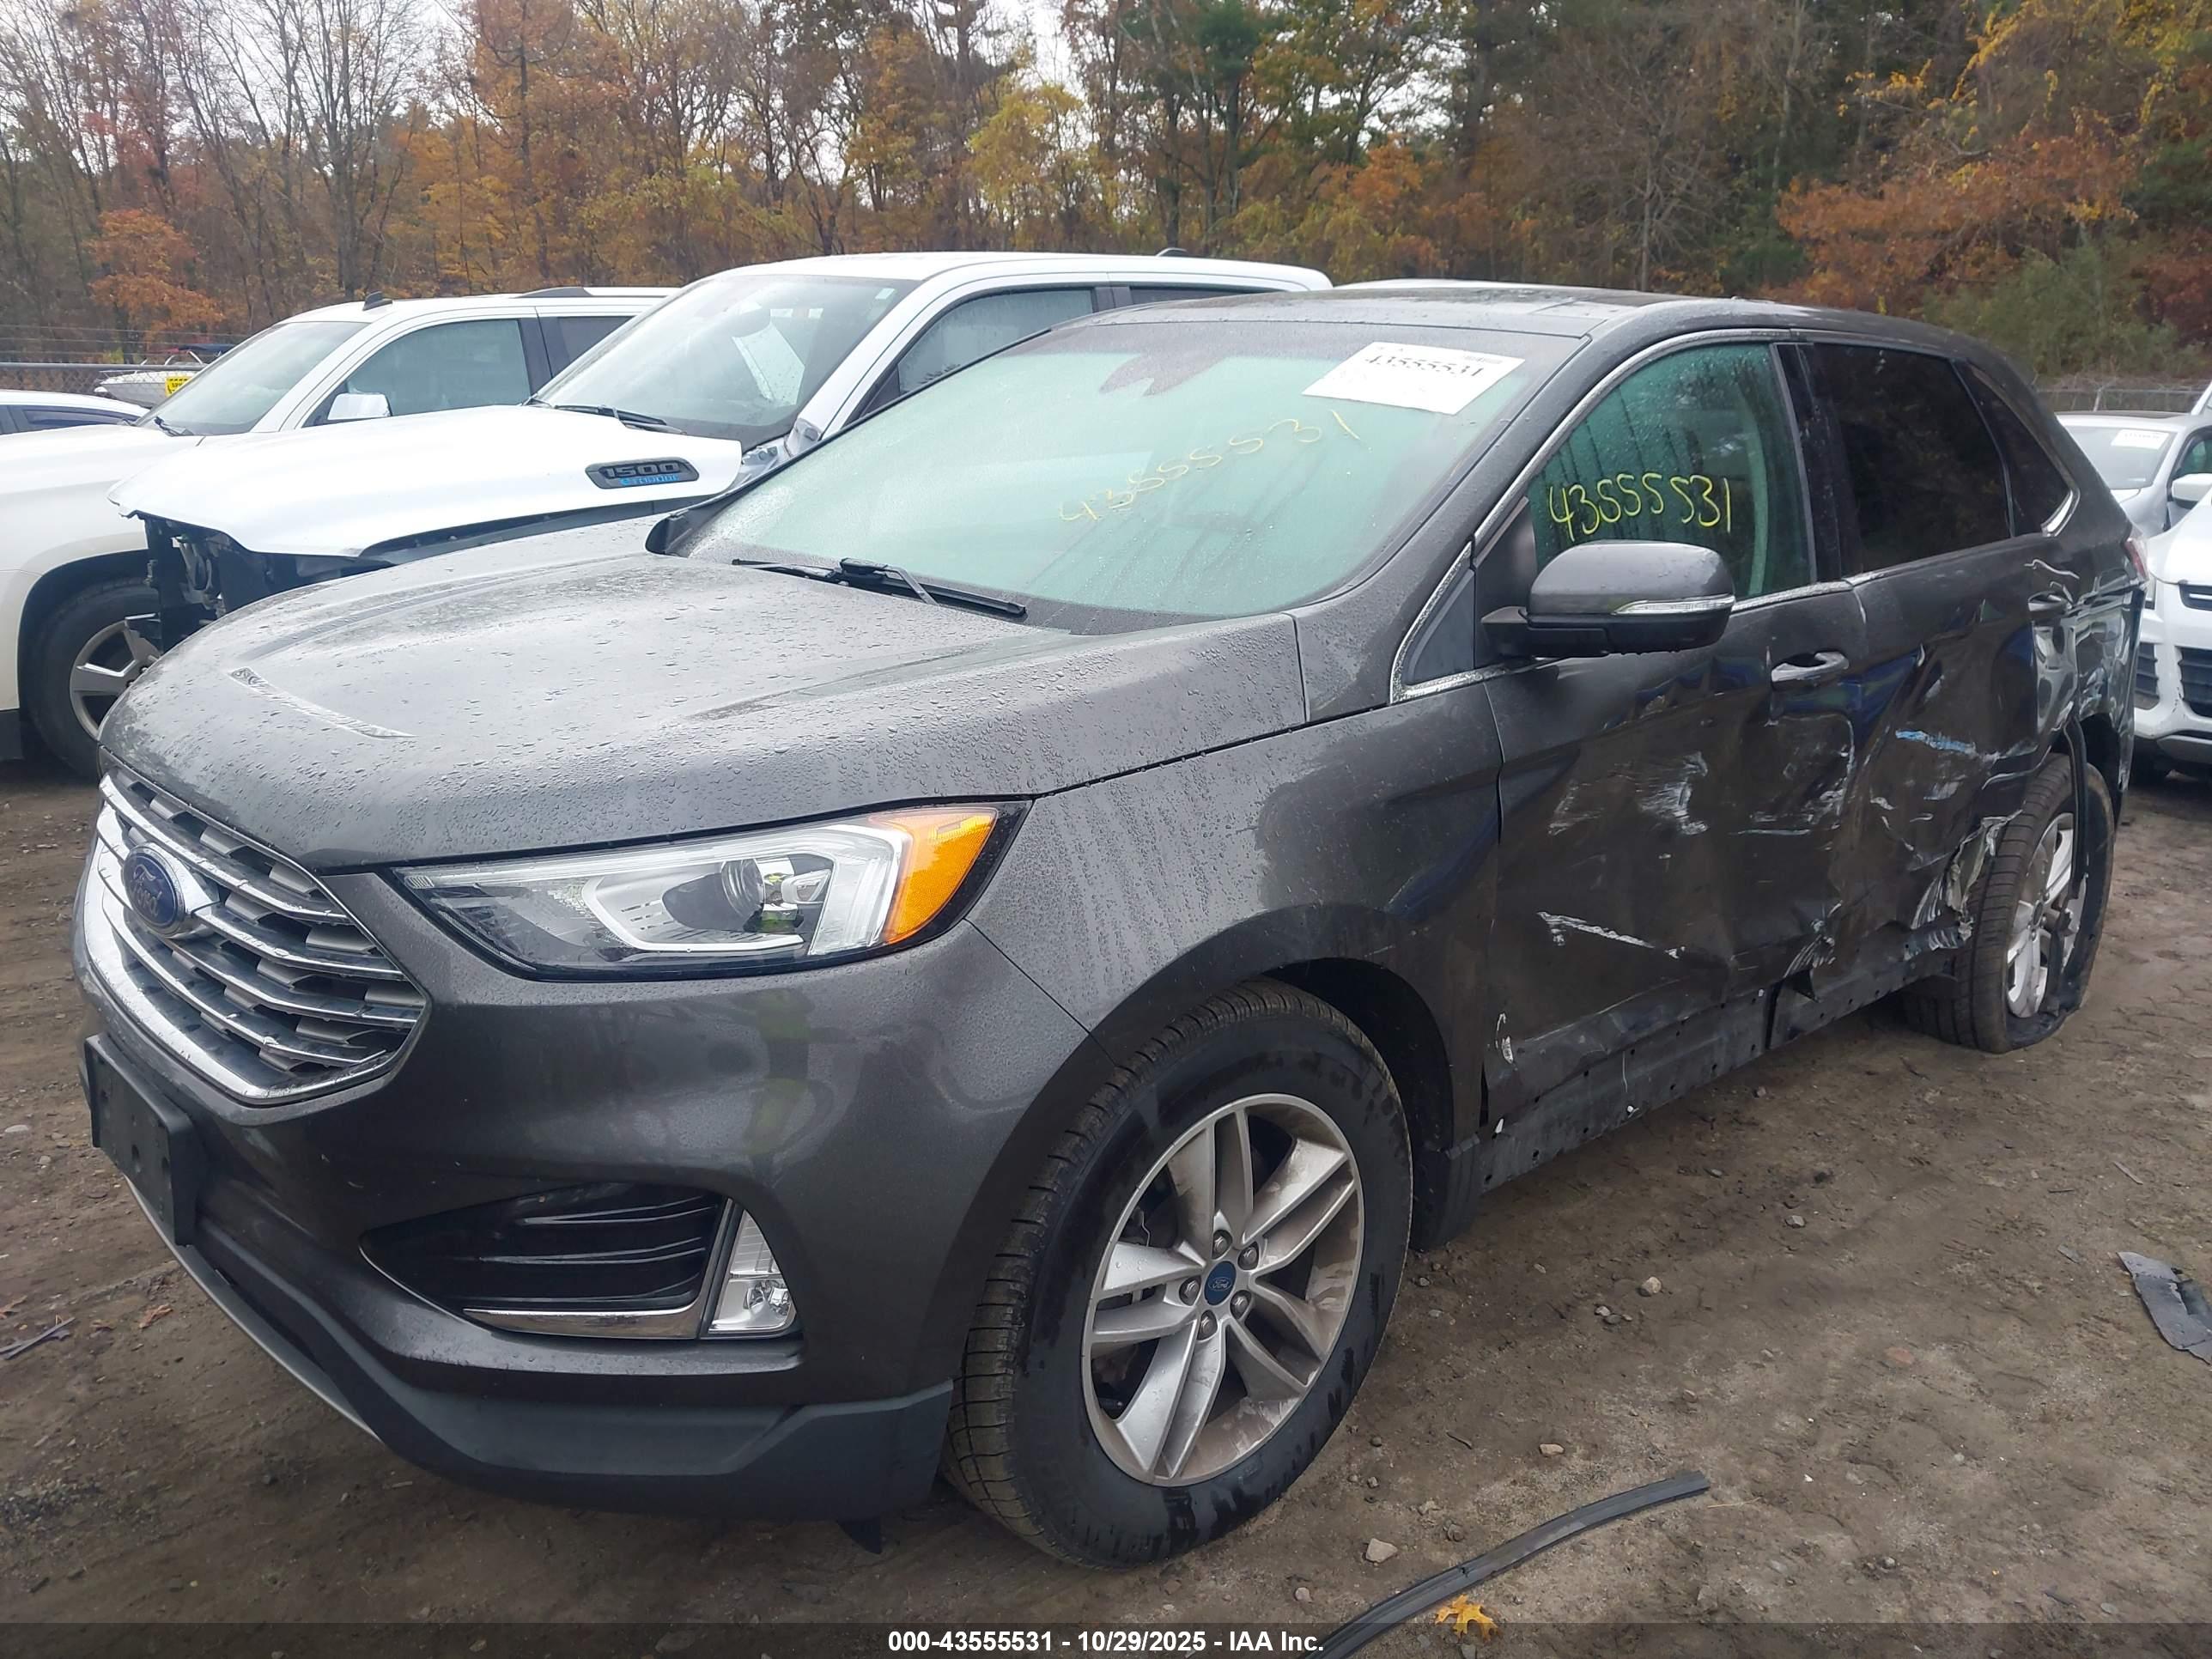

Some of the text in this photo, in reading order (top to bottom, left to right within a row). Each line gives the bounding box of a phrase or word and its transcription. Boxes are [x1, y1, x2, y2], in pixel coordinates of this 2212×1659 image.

[604, 462, 679, 478] 1500
[1060, 409, 1360, 521] 43555531
[1549, 472, 1731, 542] 43555531
